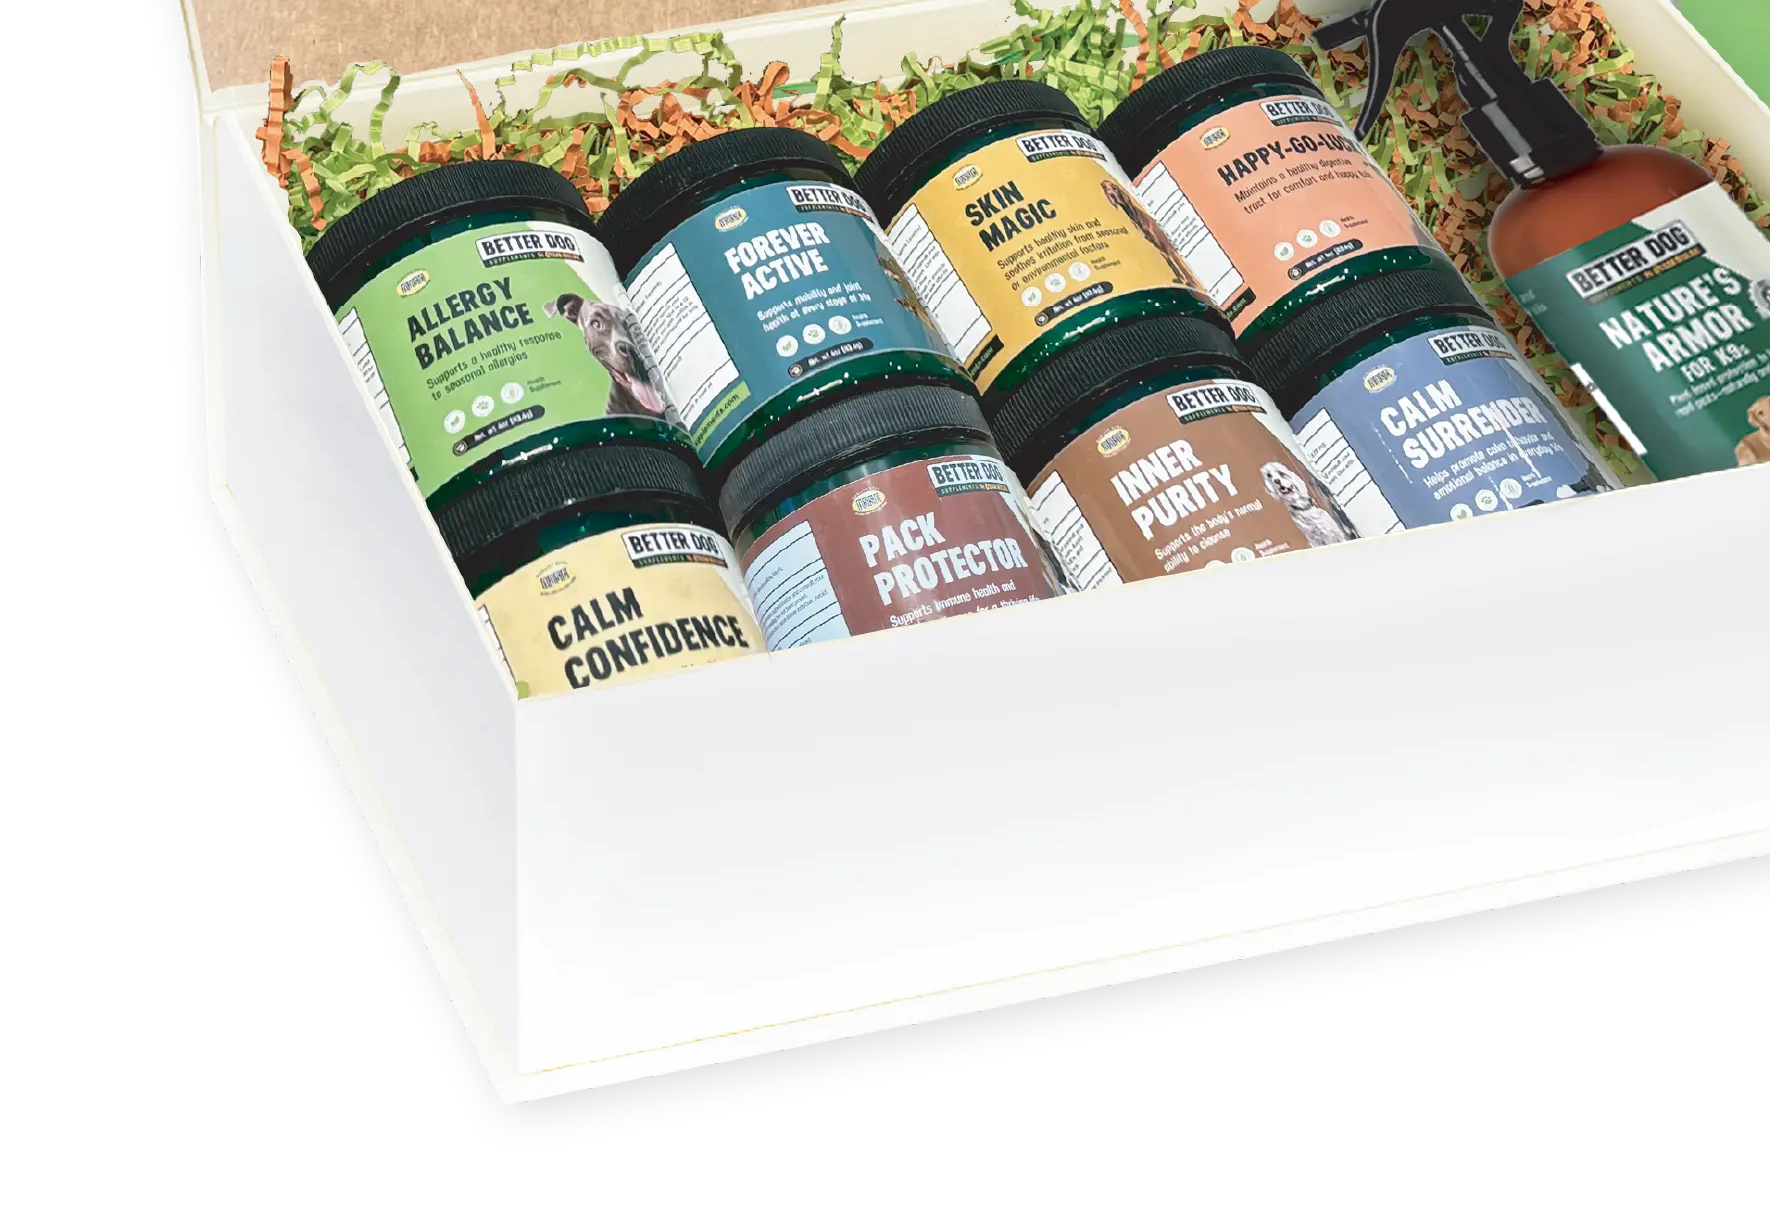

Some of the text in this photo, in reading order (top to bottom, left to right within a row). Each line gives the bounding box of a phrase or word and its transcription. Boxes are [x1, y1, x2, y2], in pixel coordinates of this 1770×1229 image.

[1266, 101, 1313, 116] BETTER
[1021, 135, 1073, 152] BETTER
[1286, 161, 1319, 177] healthy
[791, 188, 842, 203] BETTER
[965, 180, 1024, 226] SKIN
[1244, 199, 1267, 214] tract
[481, 234, 543, 256] BETTER
[544, 234, 575, 251] DOG
[724, 222, 831, 275] FOREVER
[979, 199, 1057, 252] MAGIC
[997, 217, 1102, 269] Supports healthy skin and
[741, 248, 829, 300] ACTIVE
[1005, 256, 1036, 281] soothes
[1036, 240, 1073, 259] irritation
[1074, 232, 1094, 243] from
[1011, 281, 1020, 291] or
[1080, 242, 1109, 255] factors
[1572, 246, 1649, 293] BETTER
[1644, 226, 1690, 258] DOG
[408, 277, 513, 342] ALLERGY
[756, 282, 862, 320] Supports mobility and joint
[763, 315, 790, 332] health
[790, 310, 800, 318] at
[1599, 268, 1742, 349] NATURE'S
[415, 303, 534, 370] BALANCE
[427, 331, 562, 389] Supports a healthy response
[1433, 333, 1484, 354] BETTER
[1641, 304, 1755, 373] ARMOR
[432, 351, 528, 401] to seasonal allergies
[1680, 356, 1716, 382] FOR
[1172, 387, 1229, 411] BETTER
[1380, 379, 1463, 436] CALM
[1402, 397, 1547, 469] SURRENDER
[932, 463, 983, 484] BETTER
[1110, 439, 1203, 507] INNER
[1423, 468, 1450, 488] Helps
[1451, 449, 1484, 472] promote
[1487, 440, 1506, 456] calm
[1433, 474, 1475, 500] emotional
[1474, 458, 1508, 475] balance
[1509, 452, 1519, 463] in
[1131, 464, 1238, 541] PURITY
[629, 532, 719, 554] BETTER DOG
[859, 512, 945, 568] PACK
[1155, 531, 1192, 559] Supports
[1192, 524, 1206, 537] the
[1235, 498, 1263, 517] normal
[1164, 529, 1231, 572] ability to cleanse
[873, 537, 1028, 606] PROTECTOR
[547, 587, 644, 651] CALM
[890, 579, 1016, 627] Supports immune health and
[564, 615, 749, 689] CONFIDENCE
